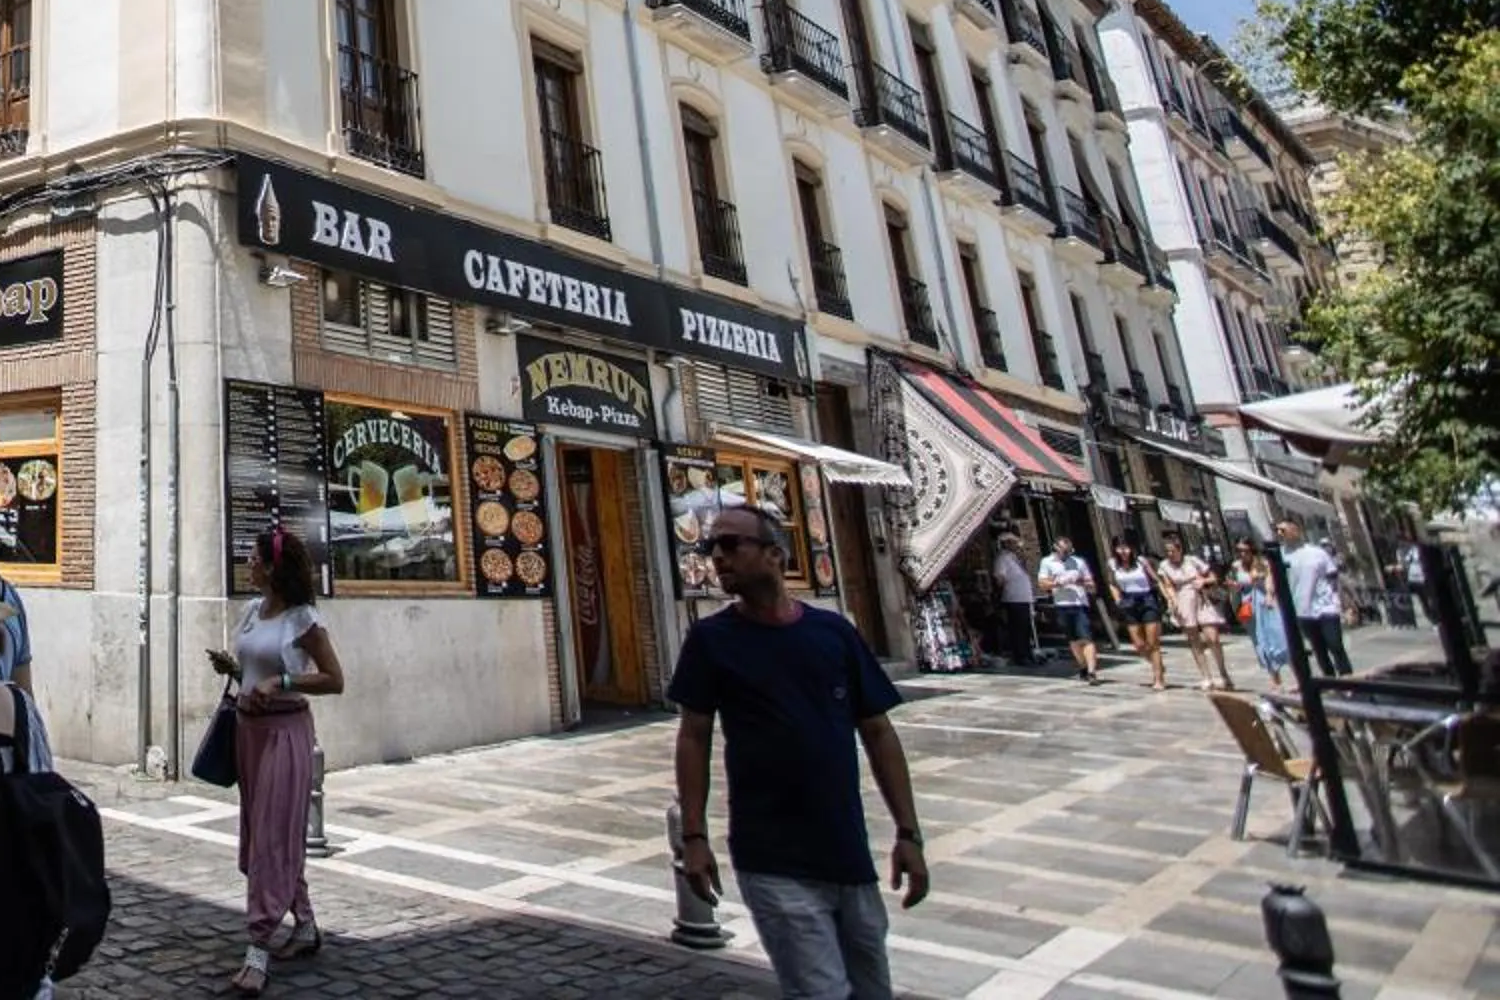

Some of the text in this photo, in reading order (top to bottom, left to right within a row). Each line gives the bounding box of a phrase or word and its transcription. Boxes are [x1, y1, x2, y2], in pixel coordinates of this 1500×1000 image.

[311, 199, 395, 263] BAR
[463, 249, 632, 327] CAFETERIA
[679, 307, 783, 363] PIZZERIA
[525, 351, 650, 419] NEMRUT
[333, 418, 443, 480] CERVECERIA
